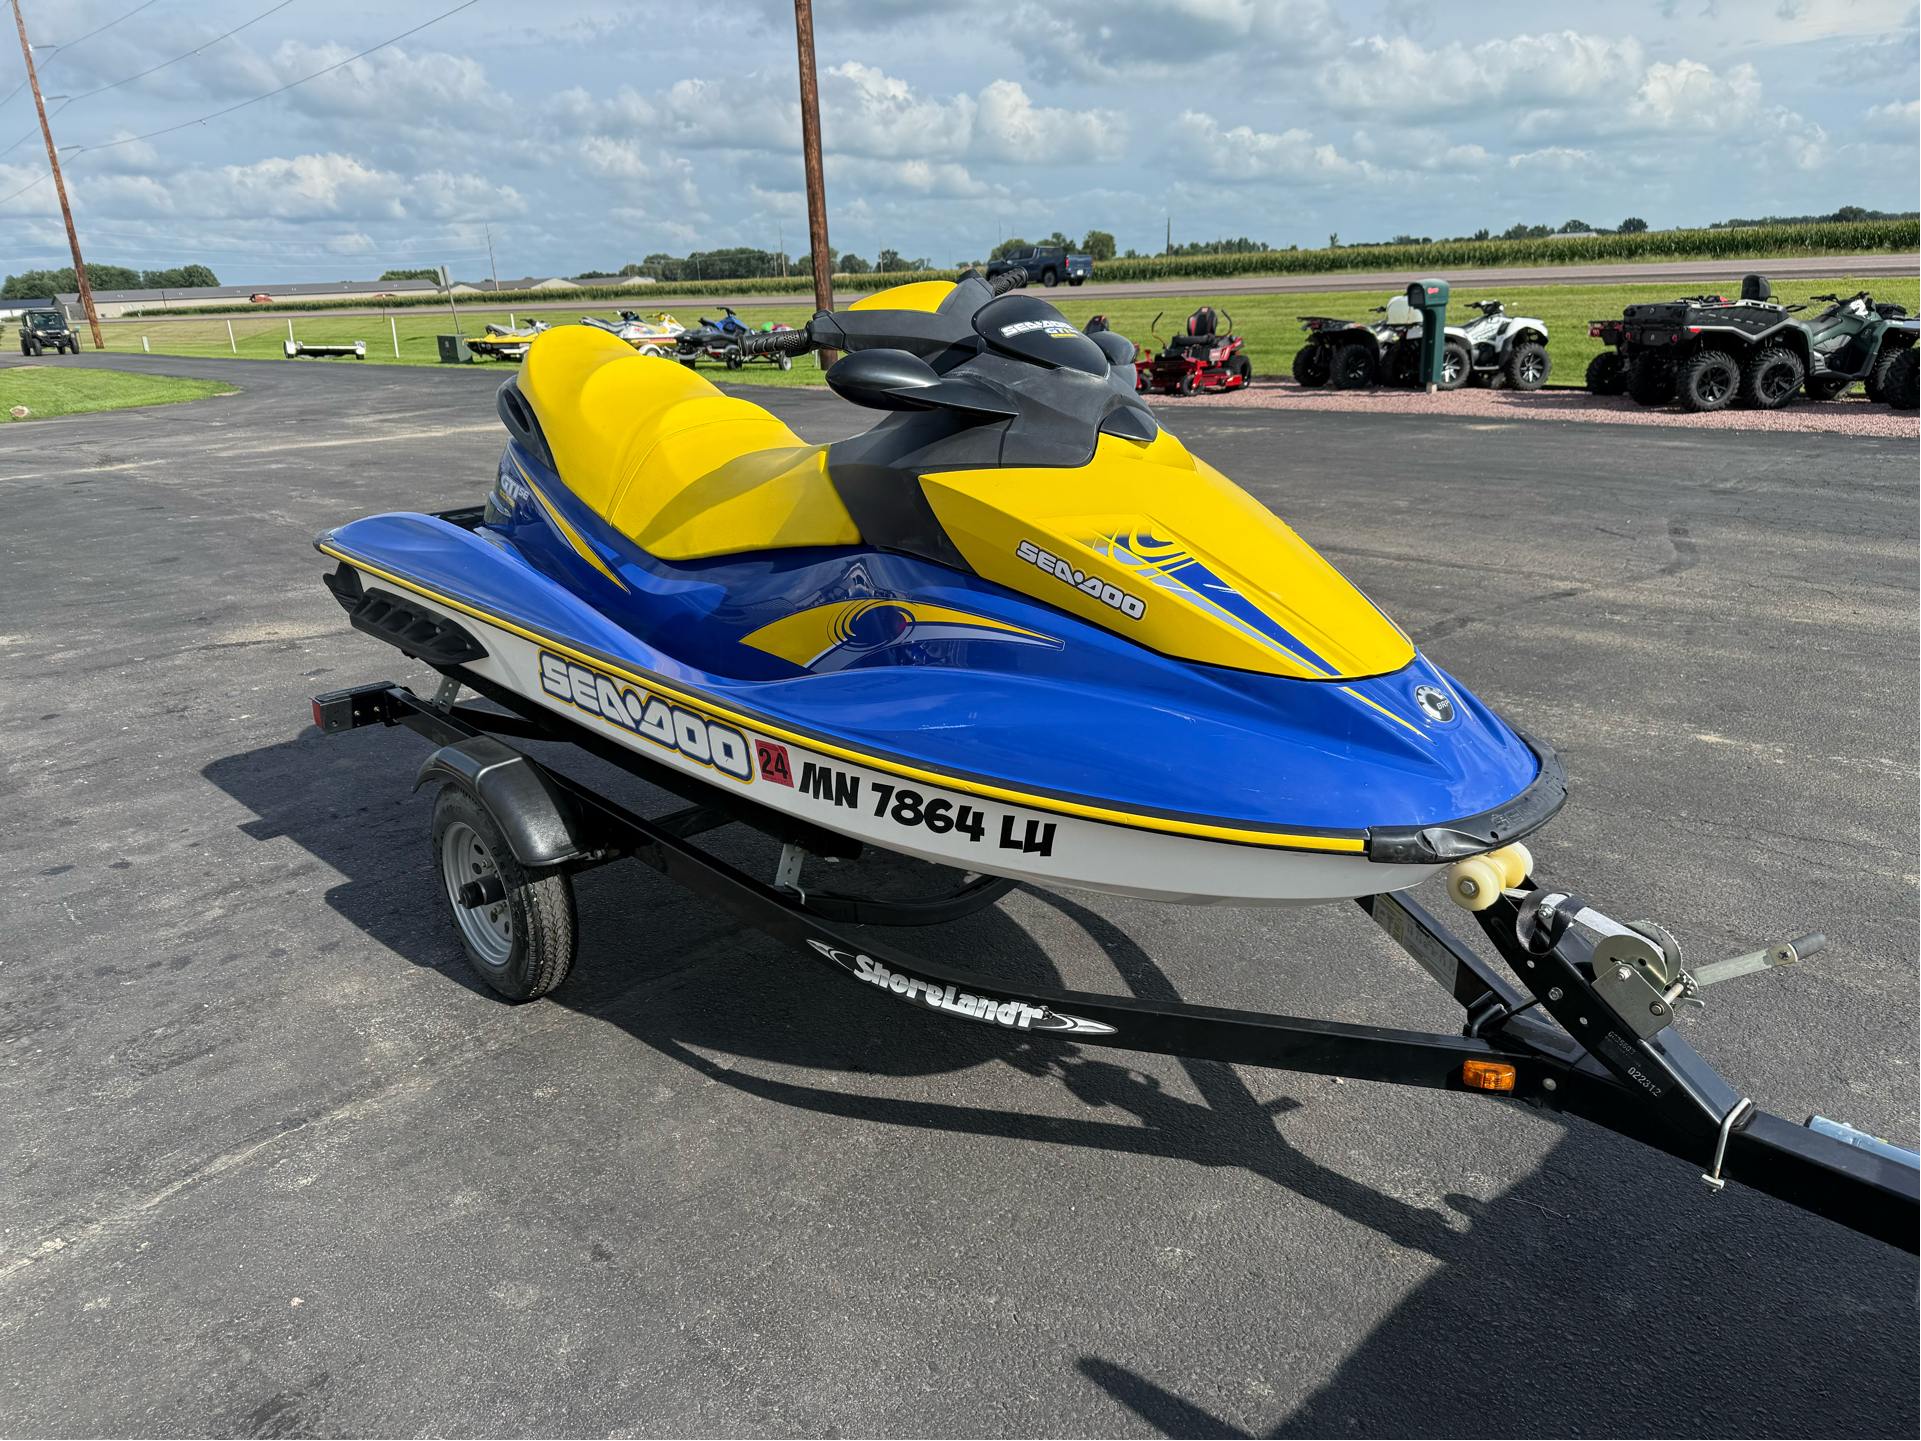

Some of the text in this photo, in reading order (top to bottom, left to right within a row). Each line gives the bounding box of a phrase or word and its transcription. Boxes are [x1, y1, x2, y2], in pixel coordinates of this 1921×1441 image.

[500, 474, 520, 500] GTI
[518, 487, 530, 501] SE
[1436, 699, 1450, 710] BRP
[758, 747, 789, 780] 24
[798, 761, 1058, 857] MN 7864 LU
[1627, 1066, 1662, 1097] 022312
